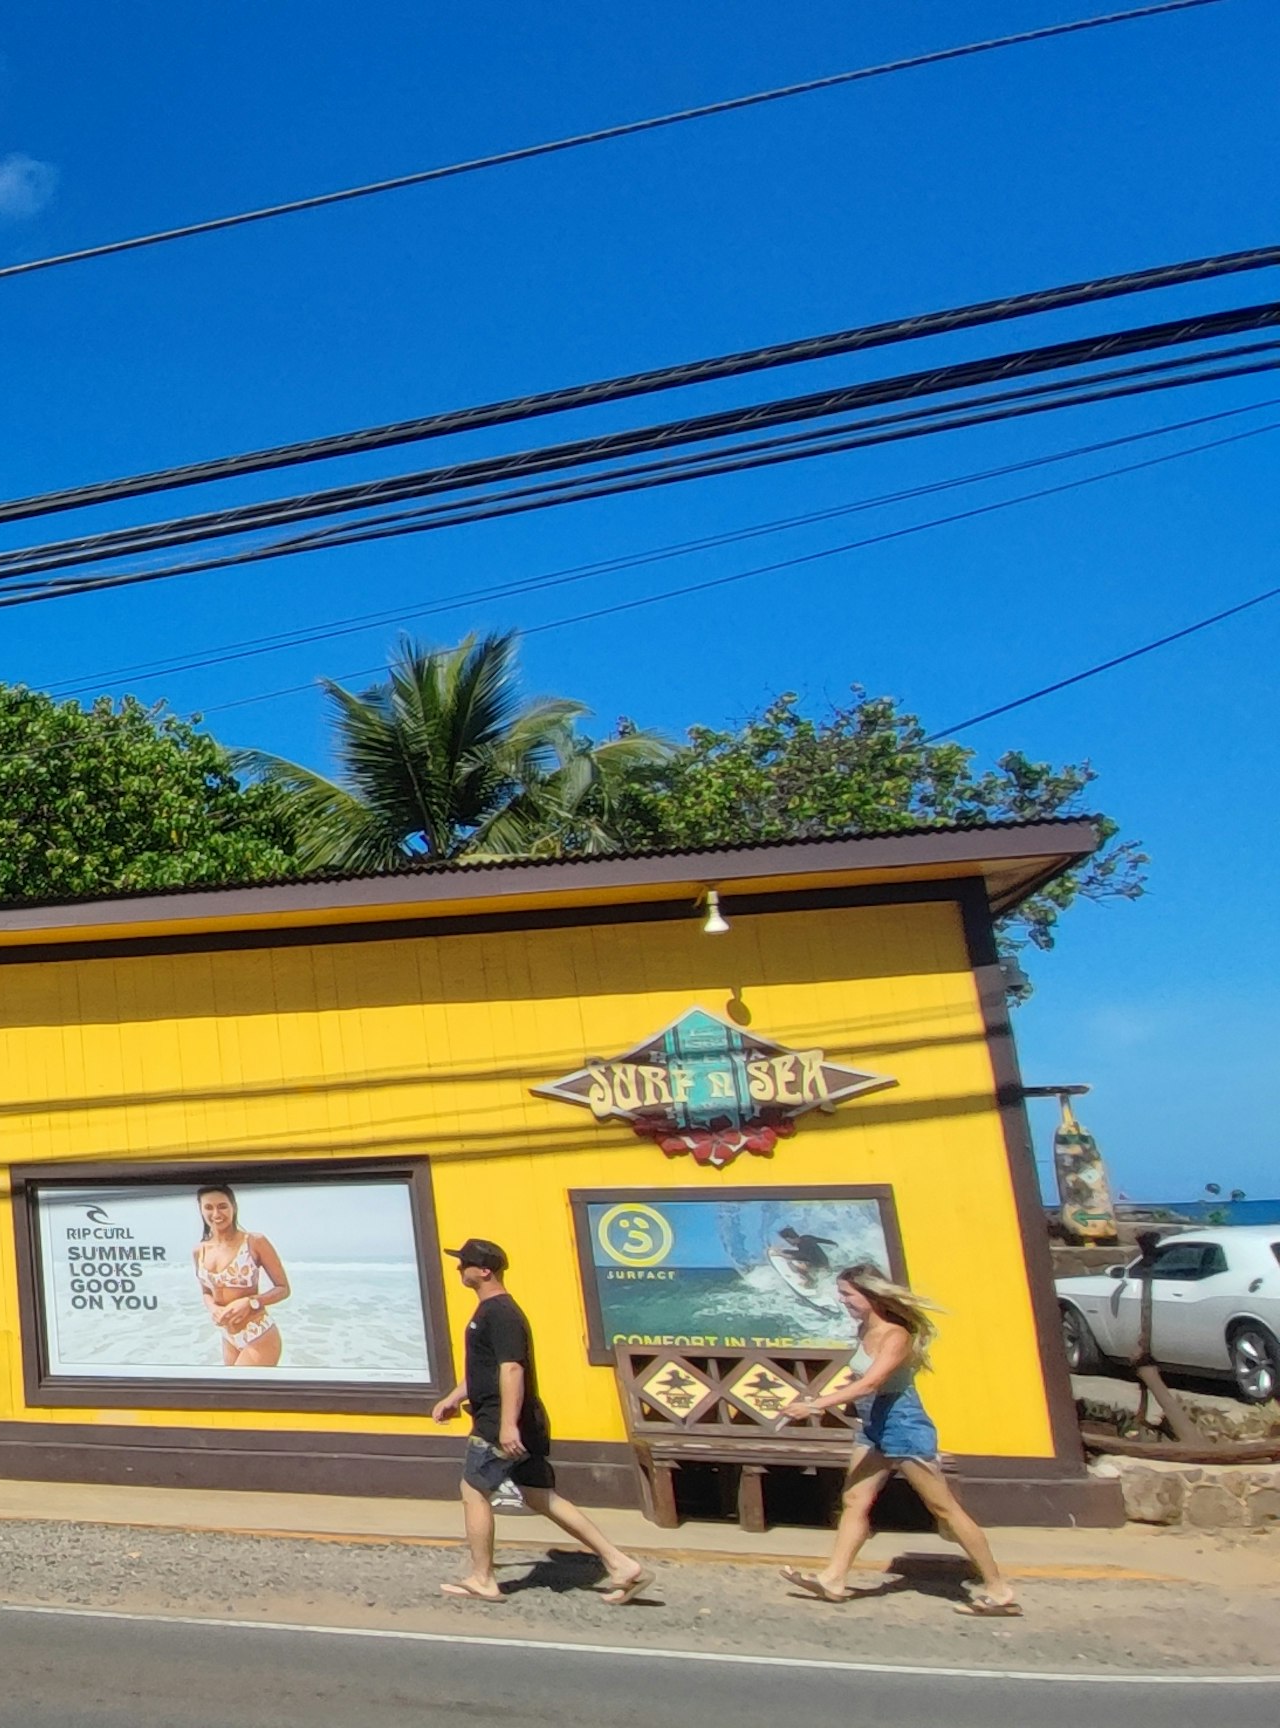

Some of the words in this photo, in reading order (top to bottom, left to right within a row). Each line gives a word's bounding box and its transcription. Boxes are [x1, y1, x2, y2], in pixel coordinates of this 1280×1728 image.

[589, 1063, 696, 1117] SURF
[747, 1050, 833, 1104] SEA
[67, 1228, 91, 1239] RIP
[93, 1228, 134, 1239] CURL
[68, 1246, 166, 1261] SUMMER
[69, 1262, 143, 1277] LOOKS
[606, 1270, 676, 1281] SURFACE
[71, 1279, 135, 1293] GOOD
[71, 1295, 103, 1310] ON
[111, 1295, 158, 1310] YOU
